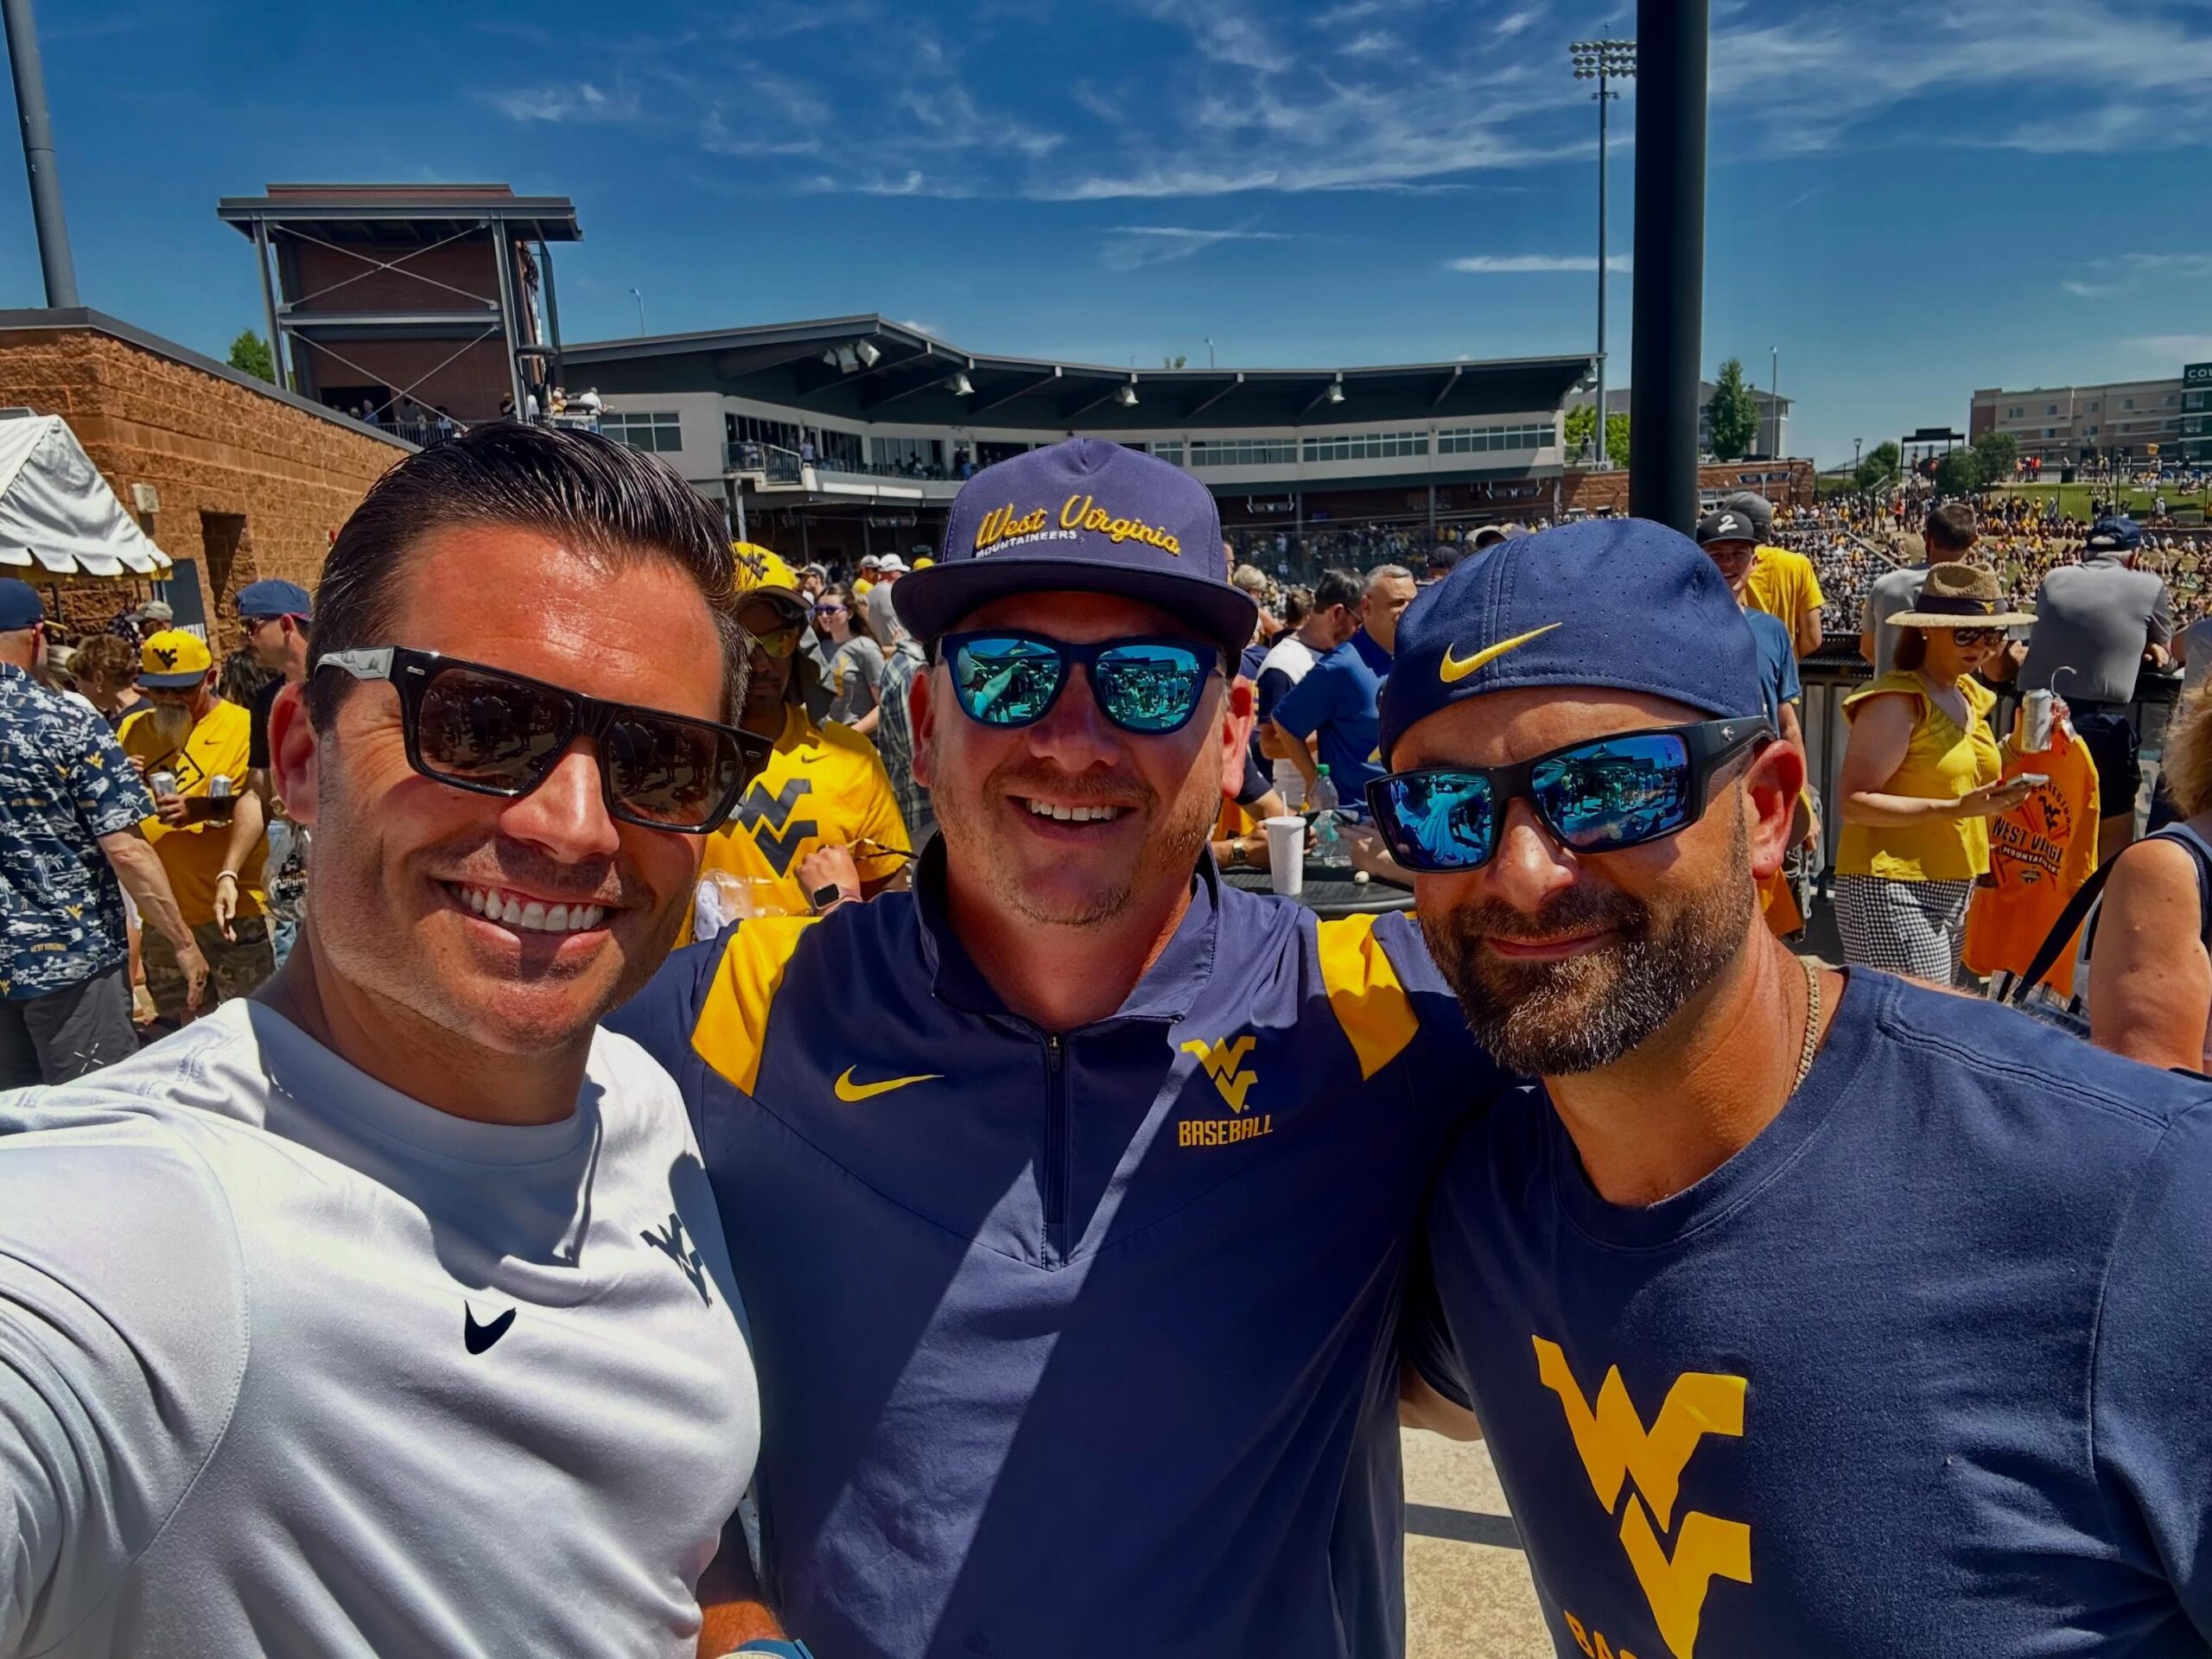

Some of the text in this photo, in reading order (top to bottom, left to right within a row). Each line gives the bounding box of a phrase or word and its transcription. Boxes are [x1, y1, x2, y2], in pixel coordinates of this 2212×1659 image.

[975, 494, 1180, 556] West Virginia
[1718, 514, 1738, 533] 2
[976, 530, 1078, 559] MOUNTAINEERS
[1993, 815, 2028, 846] WEST
[1181, 1036, 1258, 1114] WV
[1179, 1115, 1273, 1147] BASEBALL
[1532, 1334, 1752, 1659] WV
